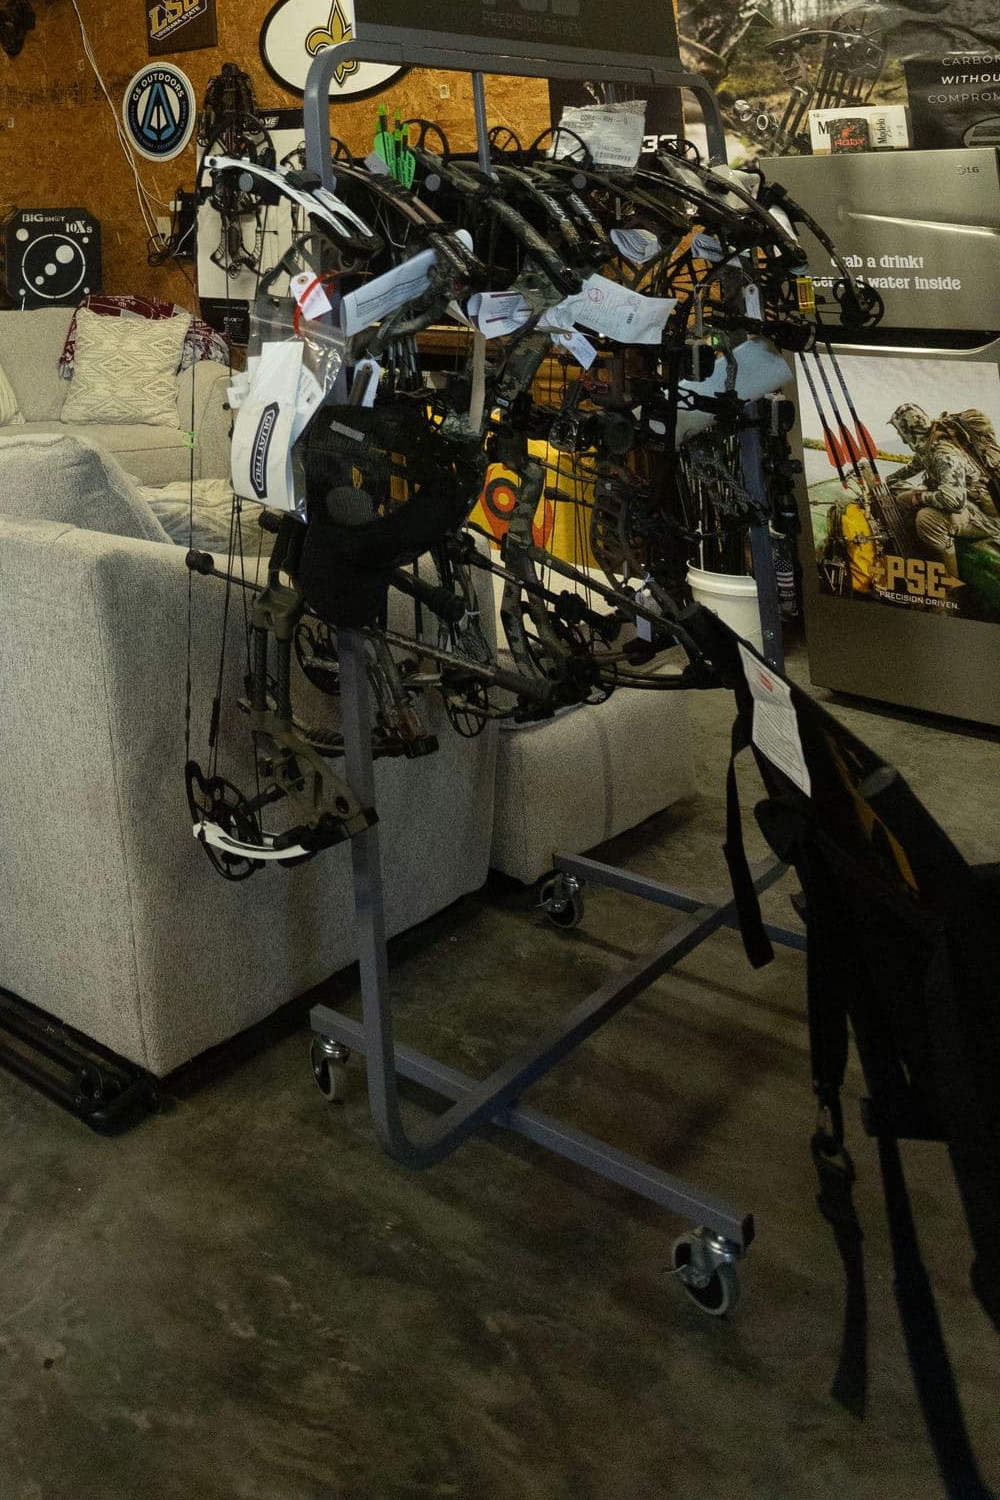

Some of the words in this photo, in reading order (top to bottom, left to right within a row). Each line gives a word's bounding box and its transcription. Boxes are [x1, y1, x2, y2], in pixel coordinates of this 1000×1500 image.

[140, 72, 184, 99] OUTDOORS
[831, 254, 863, 268] Gab
[867, 257, 877, 268] a
[879, 255, 924, 269] drink!
[867, 277, 911, 290] water
[915, 276, 961, 291] inside
[886, 554, 946, 599] PSE
[879, 590, 924, 605] PRECISION
